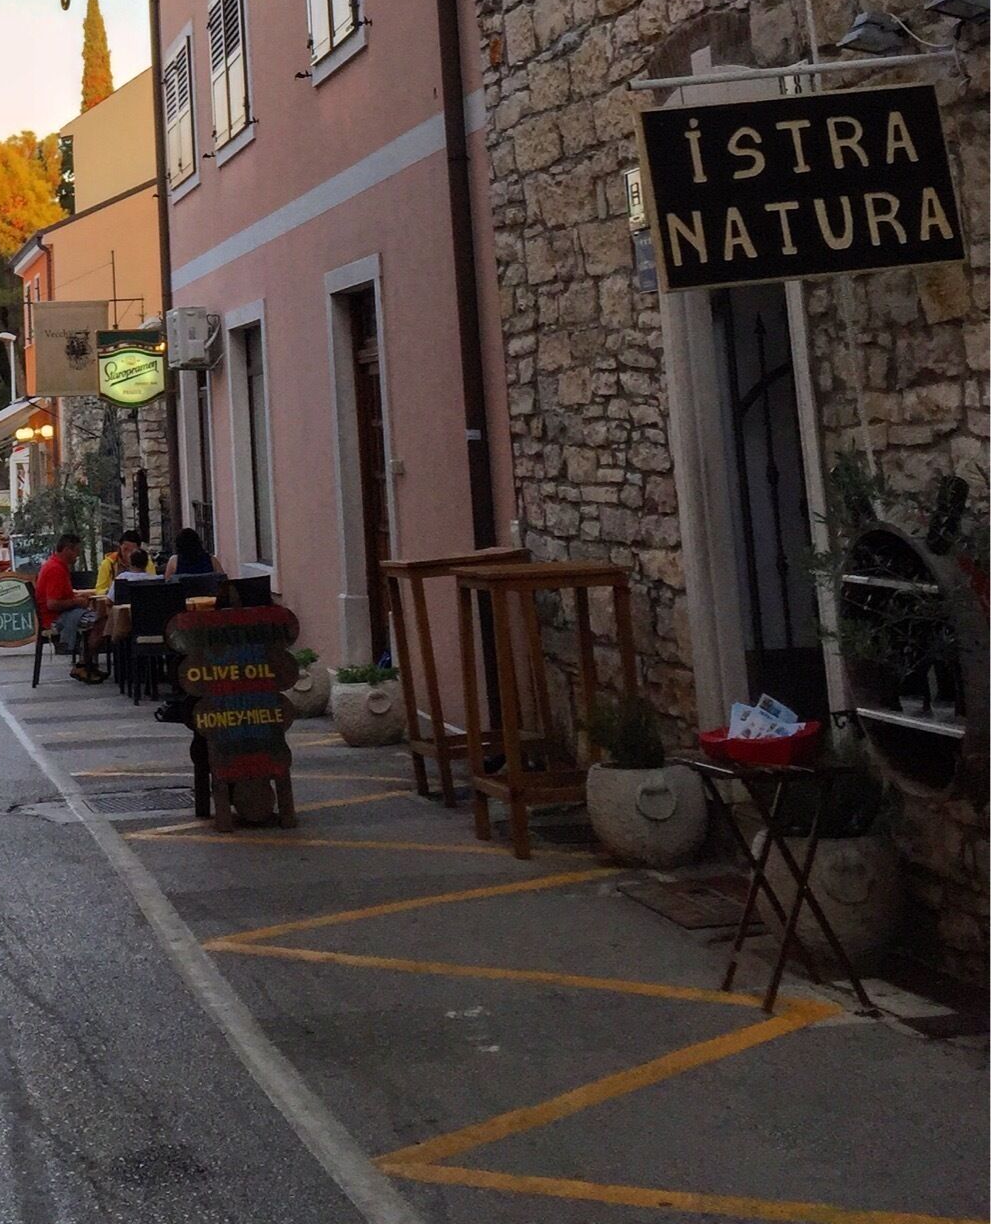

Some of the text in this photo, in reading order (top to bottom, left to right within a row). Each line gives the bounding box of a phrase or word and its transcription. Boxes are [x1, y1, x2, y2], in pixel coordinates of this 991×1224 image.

[666, 187, 954, 267] NATURA
[187, 664, 276, 682] OLIVE OIL
